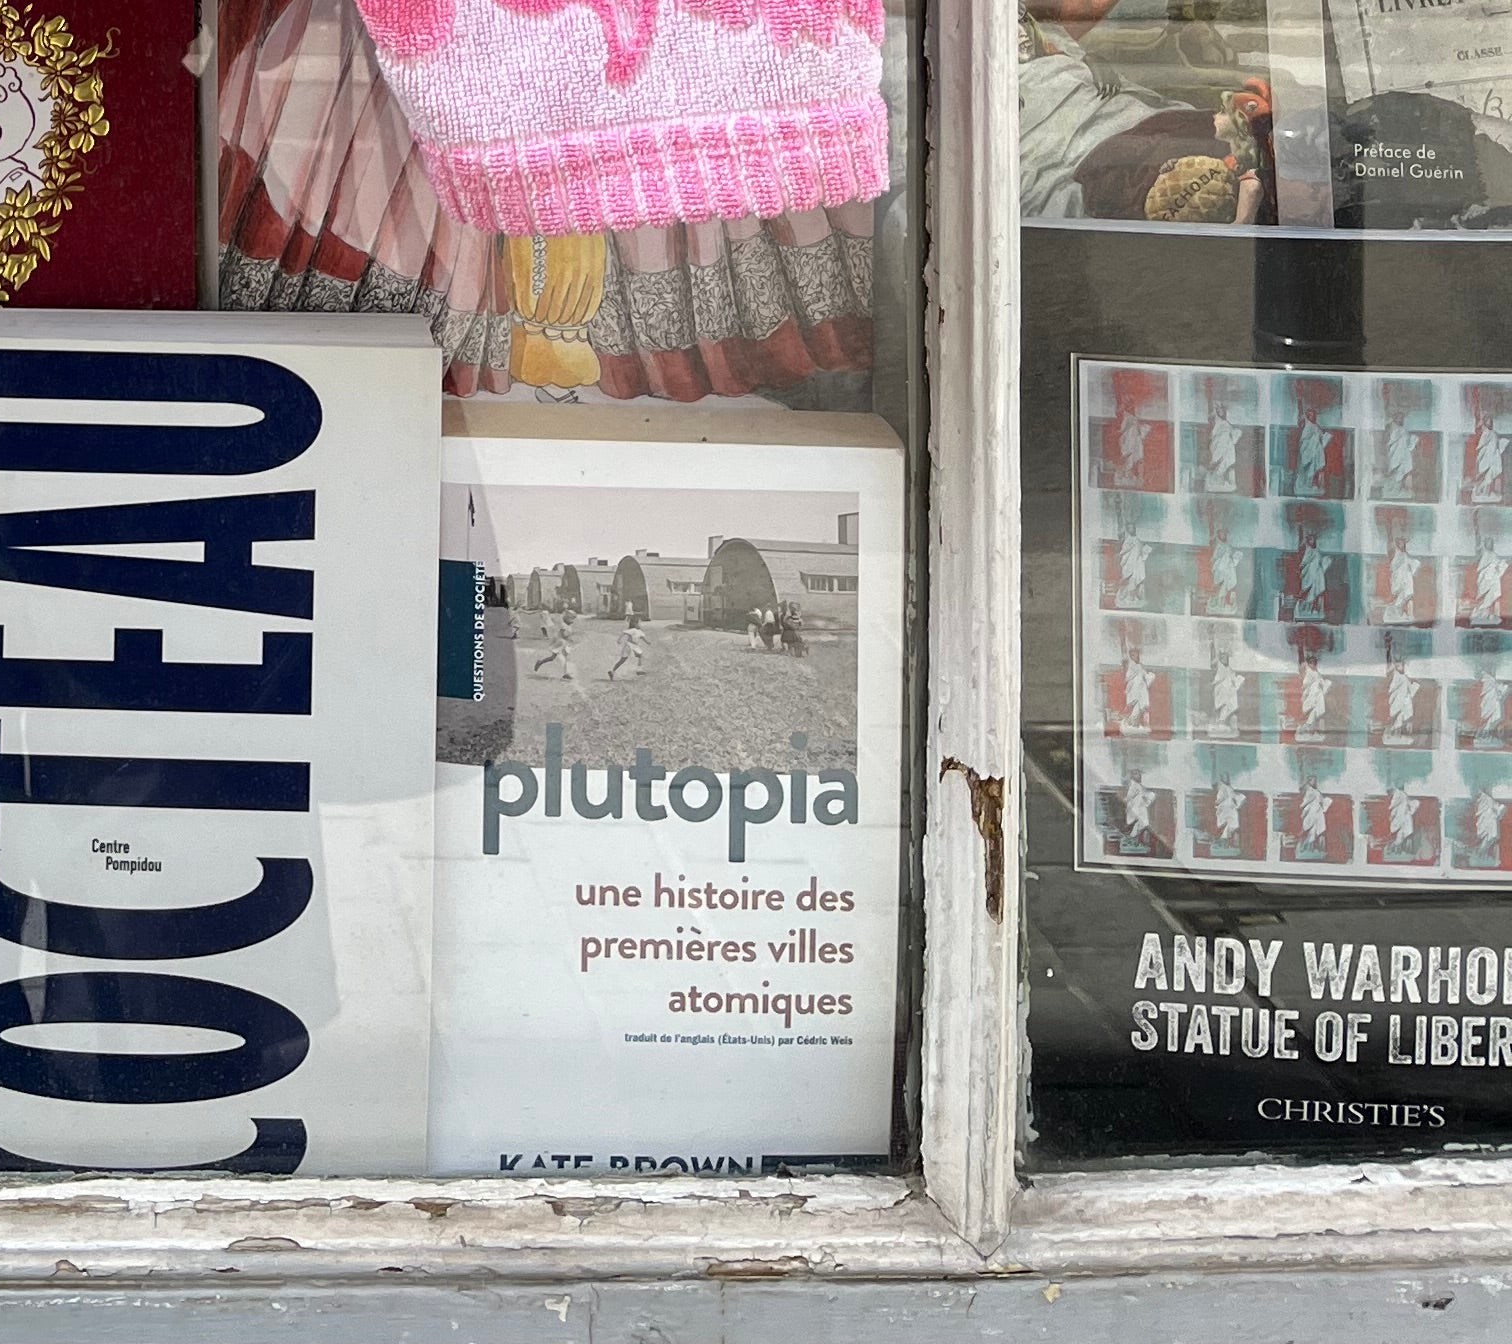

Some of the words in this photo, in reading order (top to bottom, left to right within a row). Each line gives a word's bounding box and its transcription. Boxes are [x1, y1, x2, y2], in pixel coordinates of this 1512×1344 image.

[1456, 46, 1504, 62] CLASSE
[1353, 142, 1417, 160] Préface
[1420, 143, 1436, 160] de
[1354, 162, 1404, 179] Daniel
[1409, 163, 1464, 181] Guérin
[473, 560, 486, 611] SOCIÉTÉ
[474, 612, 485, 630] DE
[473, 633, 486, 702] QUESTIONS
[482, 722, 859, 863] plutopia
[91, 838, 130, 854] Centre
[105, 856, 162, 876] Pompidou
[575, 883, 643, 908] une
[654, 872, 785, 912] histoire
[795, 876, 856, 913] des
[580, 925, 756, 973] premières
[767, 928, 854, 964] villes
[1133, 931, 1284, 998] ANDY
[667, 979, 854, 1029] atomiques
[624, 1032, 658, 1043] traduit
[660, 1034, 672, 1043] de
[674, 1033, 716, 1047] l'anglais
[718, 1032, 776, 1047] (États-Unis)
[777, 1036, 794, 1048] par
[796, 1034, 828, 1046] Cédric
[830, 1035, 854, 1046] Weis
[1130, 999, 1301, 1061] STATUE
[1314, 1010, 1373, 1063] OF
[1387, 1013, 1512, 1068] LIBER
[1256, 1096, 1447, 1129] CHRISTIE'S
